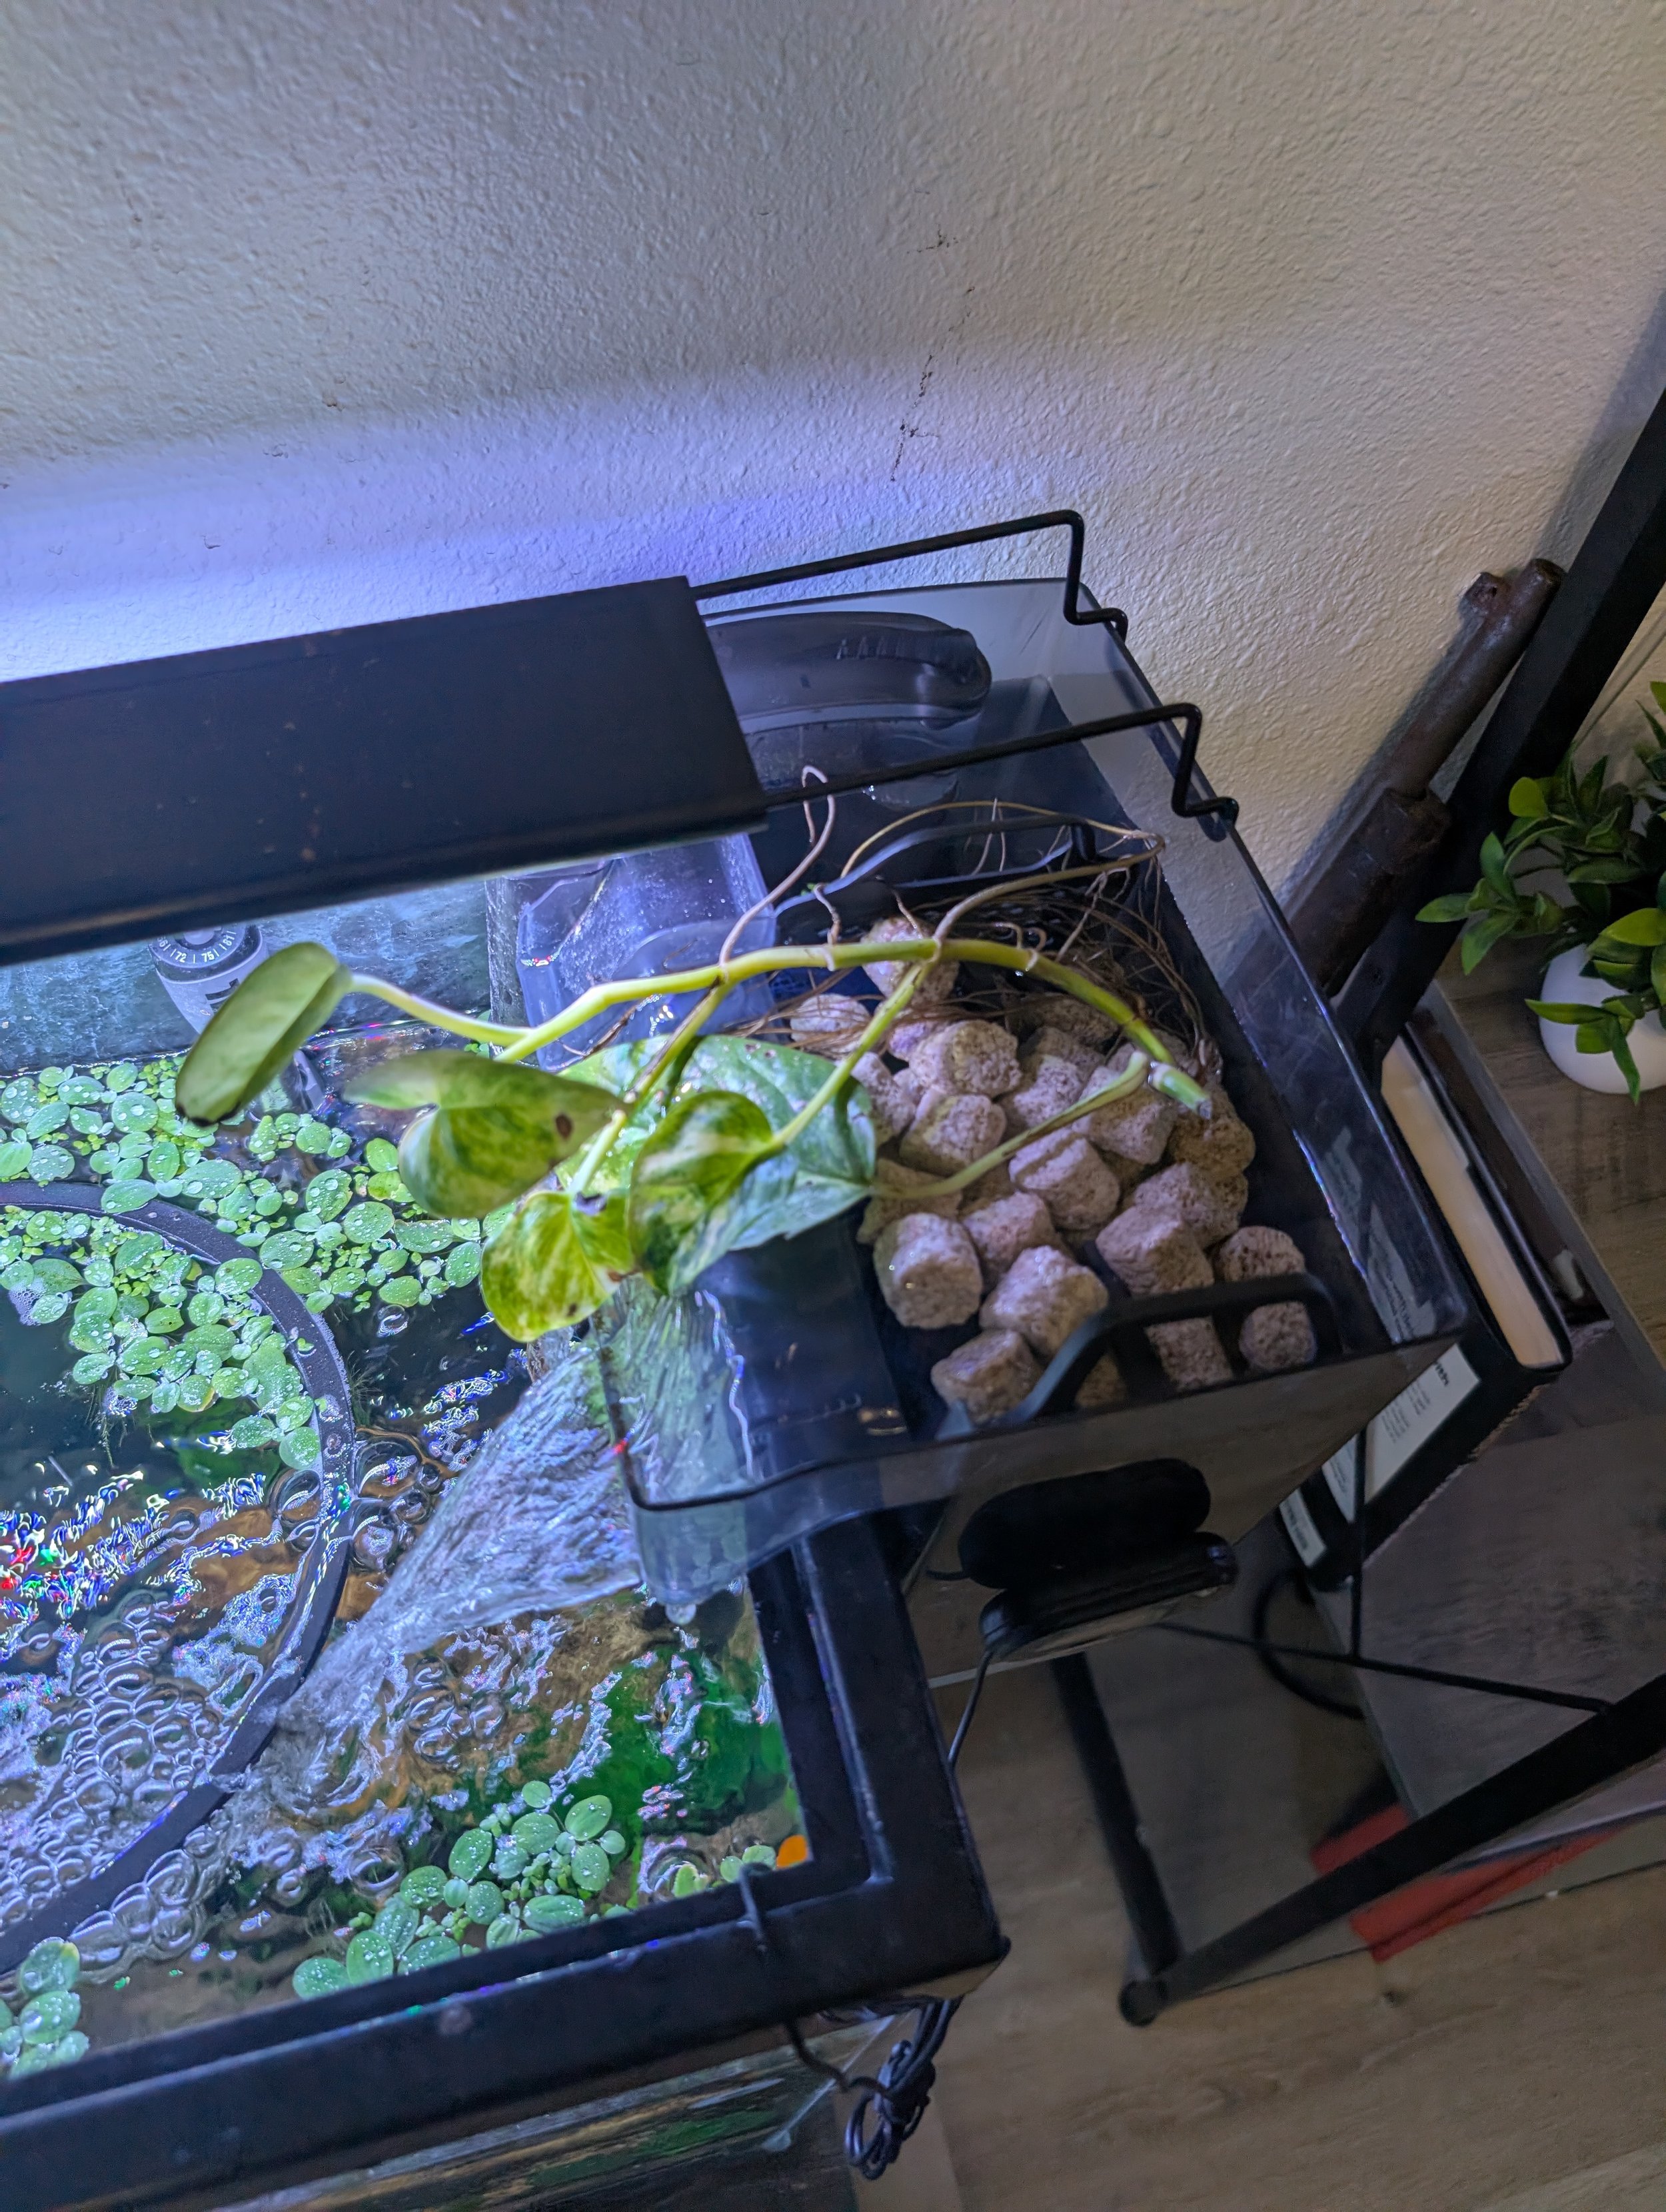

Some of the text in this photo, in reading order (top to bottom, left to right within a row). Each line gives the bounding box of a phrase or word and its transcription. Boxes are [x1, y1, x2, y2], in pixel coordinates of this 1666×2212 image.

[175, 951, 187, 963] 72
[201, 951, 215, 963] 75
[223, 934, 235, 946] 81
